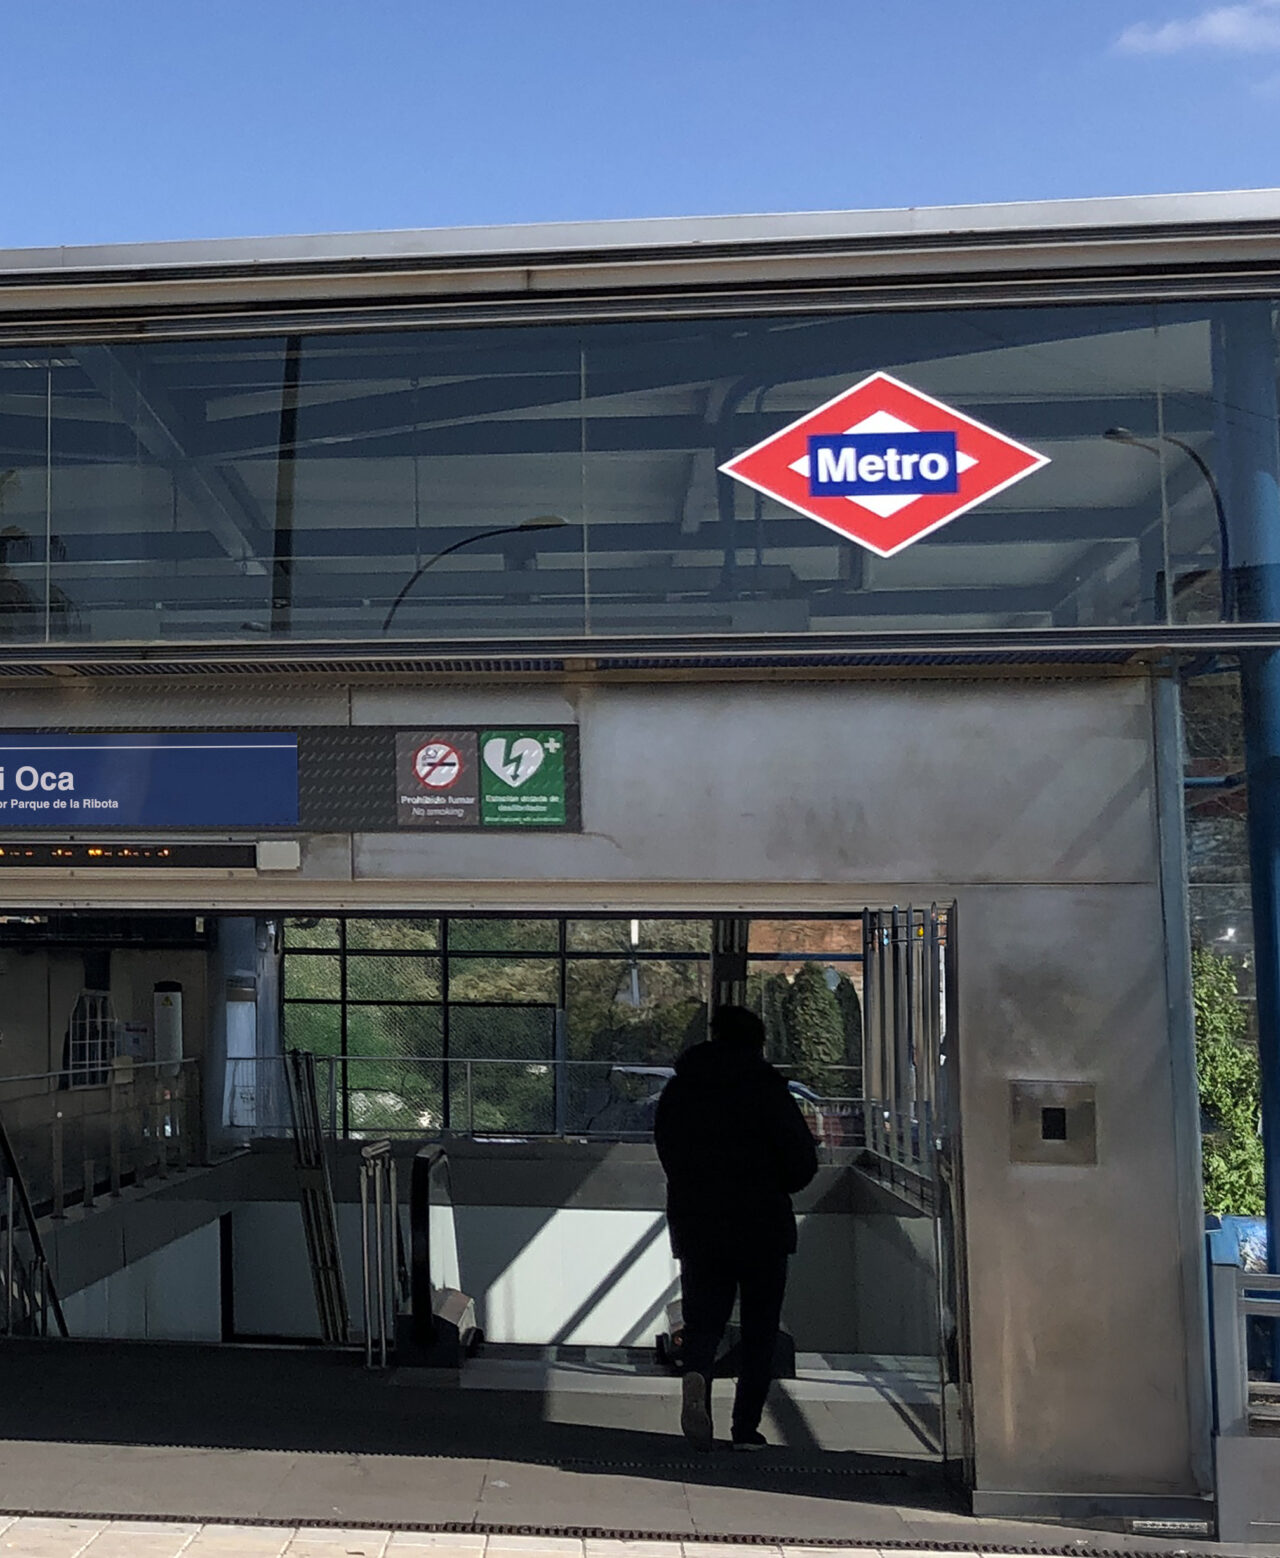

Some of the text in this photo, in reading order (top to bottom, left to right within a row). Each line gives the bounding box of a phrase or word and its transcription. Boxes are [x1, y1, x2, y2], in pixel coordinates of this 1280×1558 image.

[817, 447, 949, 484] Metro
[14, 765, 75, 791] Oca
[10, 798, 50, 811] Parque
[52, 798, 67, 809] de
[70, 798, 80, 809] la
[83, 798, 119, 809] Ribota
[448, 795, 475, 804] fumar
